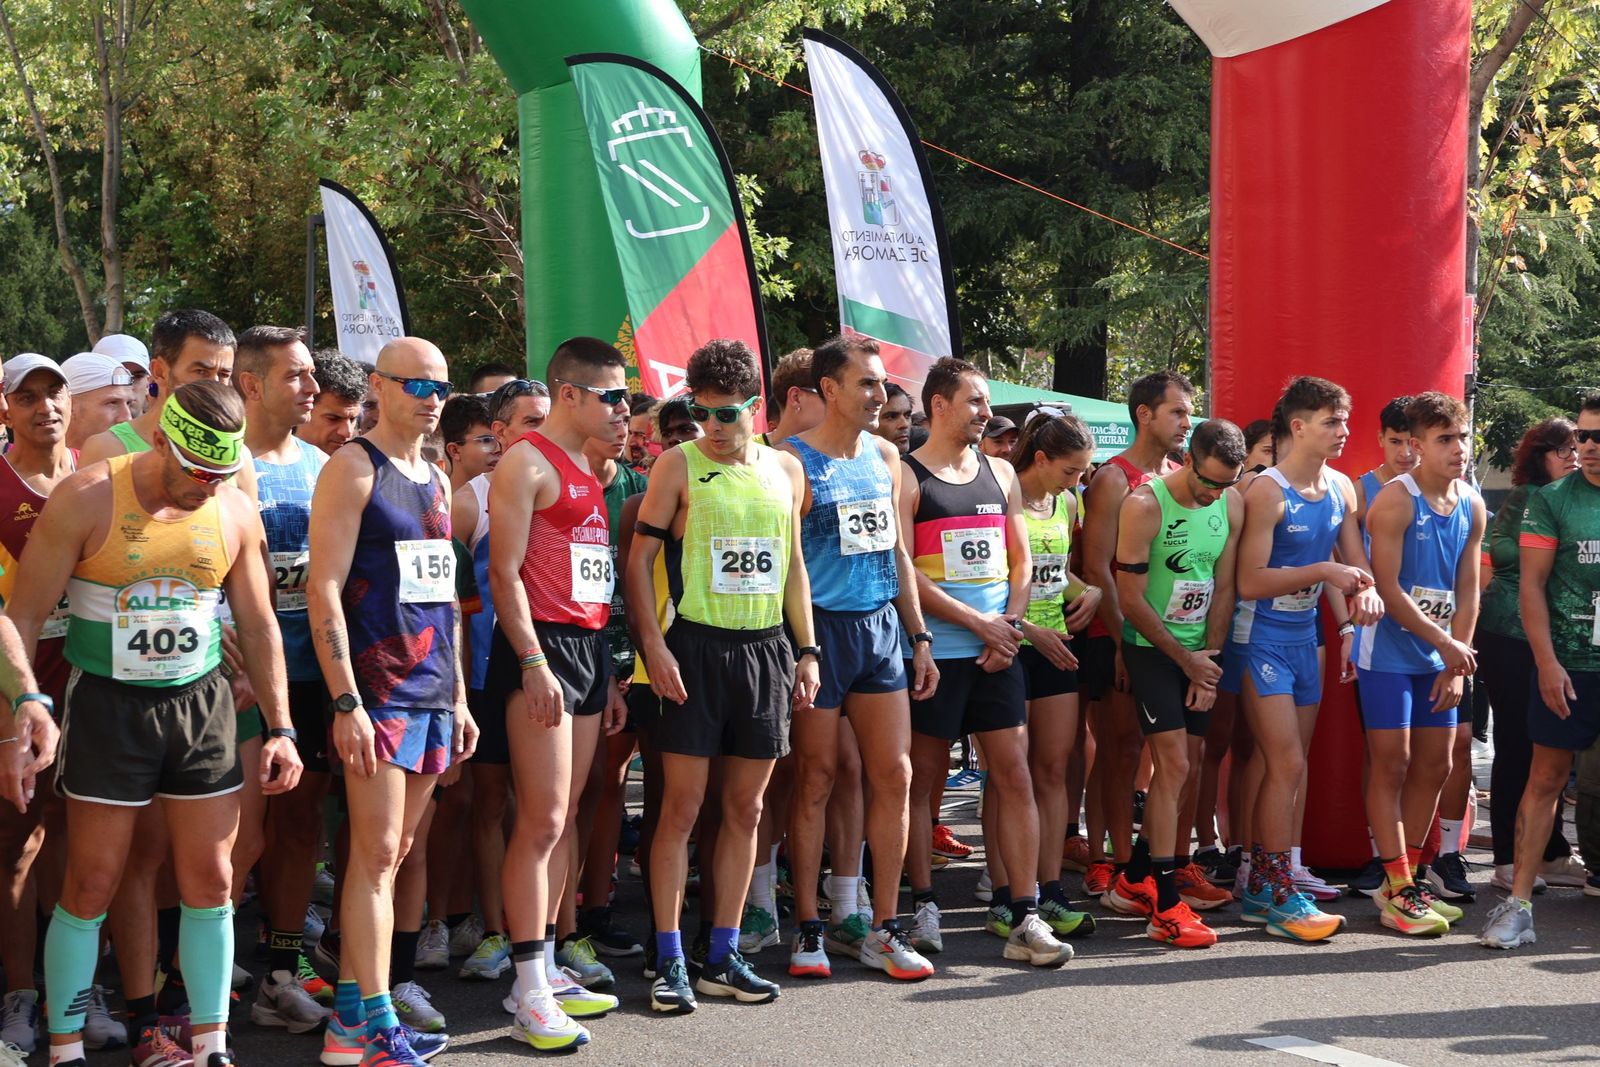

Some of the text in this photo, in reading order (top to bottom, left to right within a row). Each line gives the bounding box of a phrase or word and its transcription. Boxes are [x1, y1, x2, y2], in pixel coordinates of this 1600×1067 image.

[1098, 435, 1129, 445] RURAL
[848, 510, 889, 535] 363
[721, 550, 773, 574] 286
[960, 539, 991, 561] 68
[411, 554, 451, 579] 156
[580, 557, 611, 583] 638
[1418, 599, 1452, 620] 242
[127, 626, 199, 656] 403
